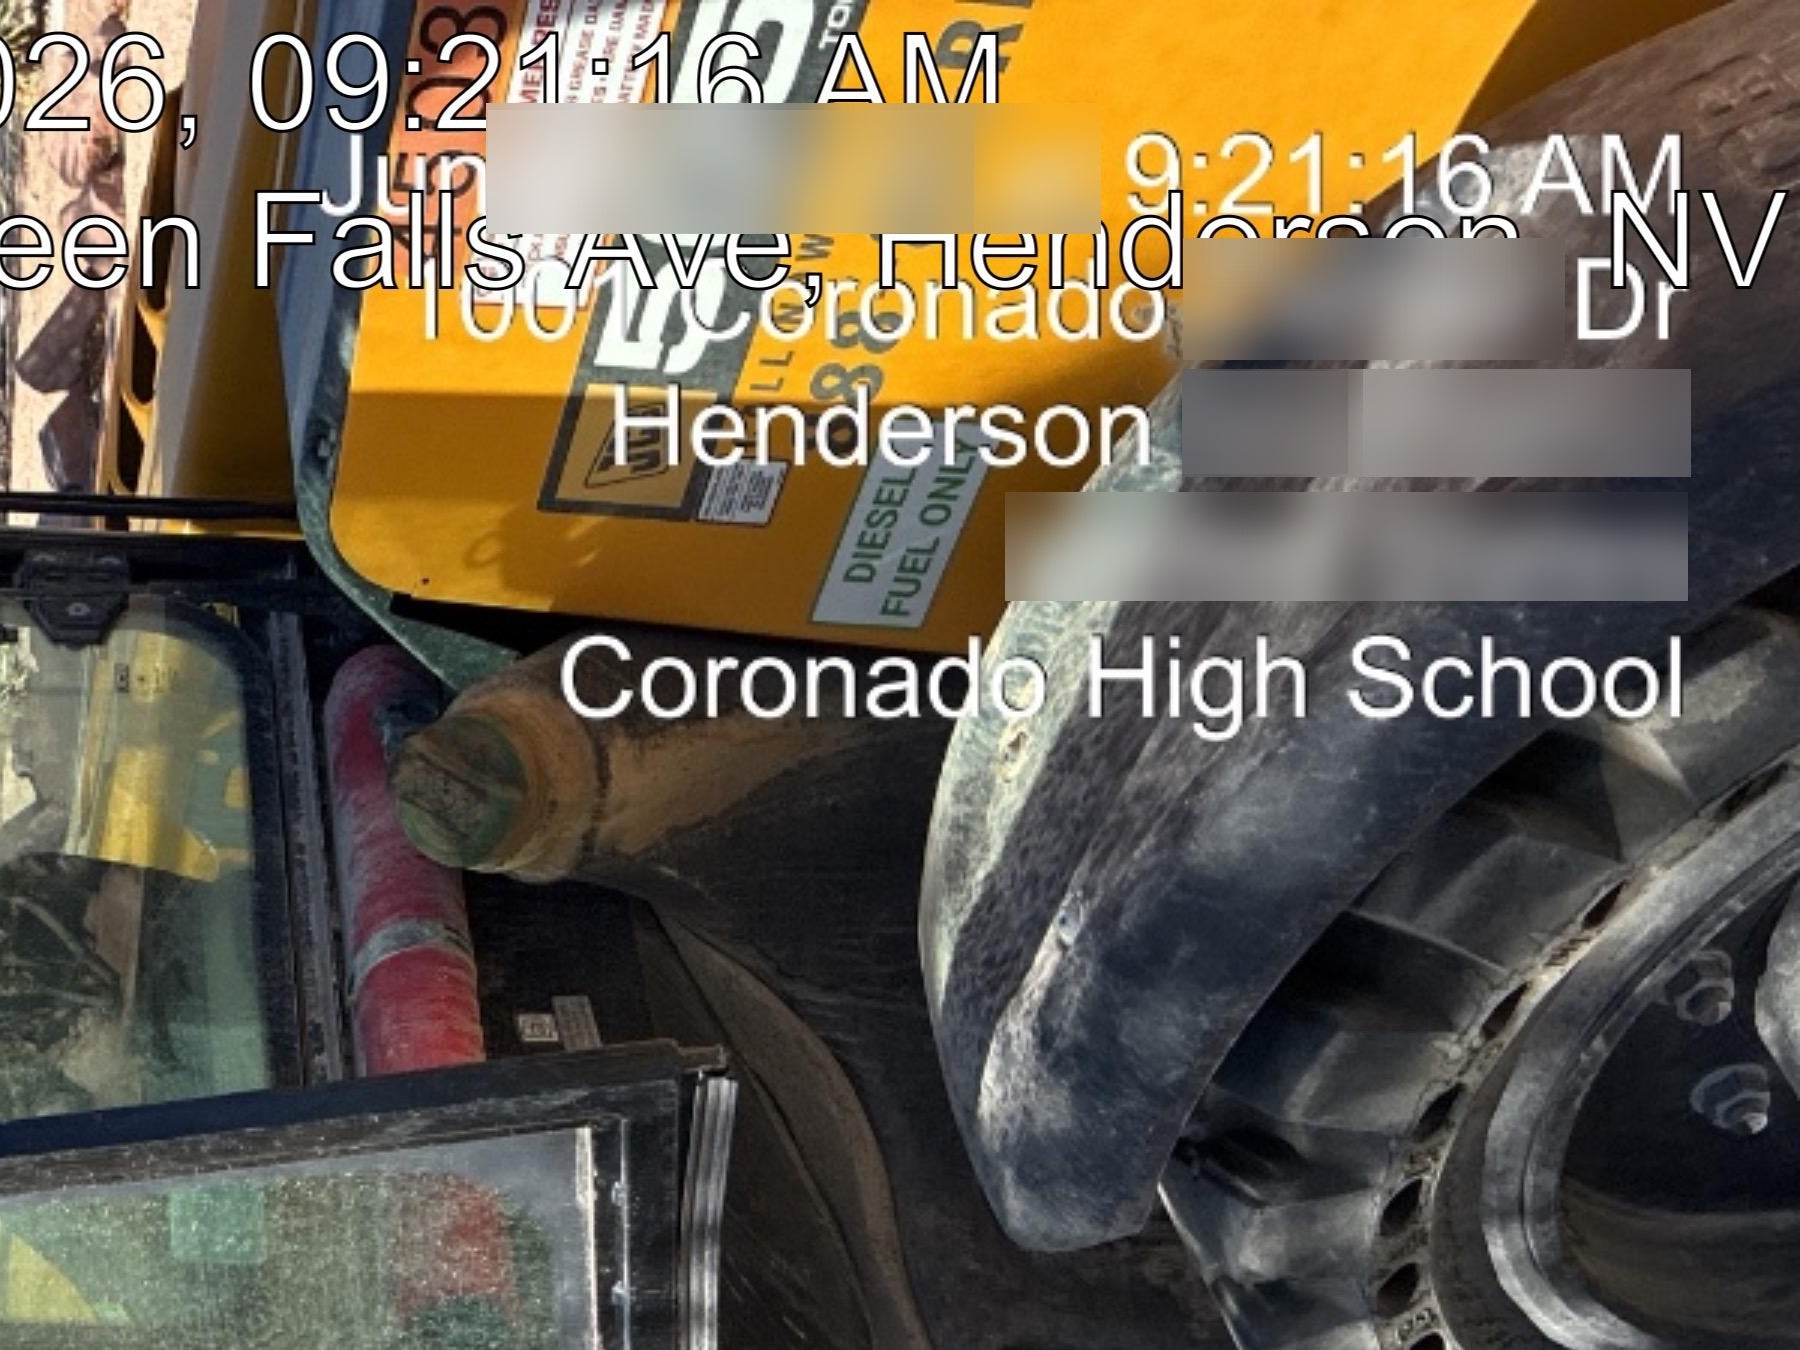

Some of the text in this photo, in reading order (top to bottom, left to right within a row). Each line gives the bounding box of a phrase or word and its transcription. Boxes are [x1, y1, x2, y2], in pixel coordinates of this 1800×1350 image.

[842, 466, 917, 584] DIESEL
[880, 433, 978, 618] FUEL ONLY
